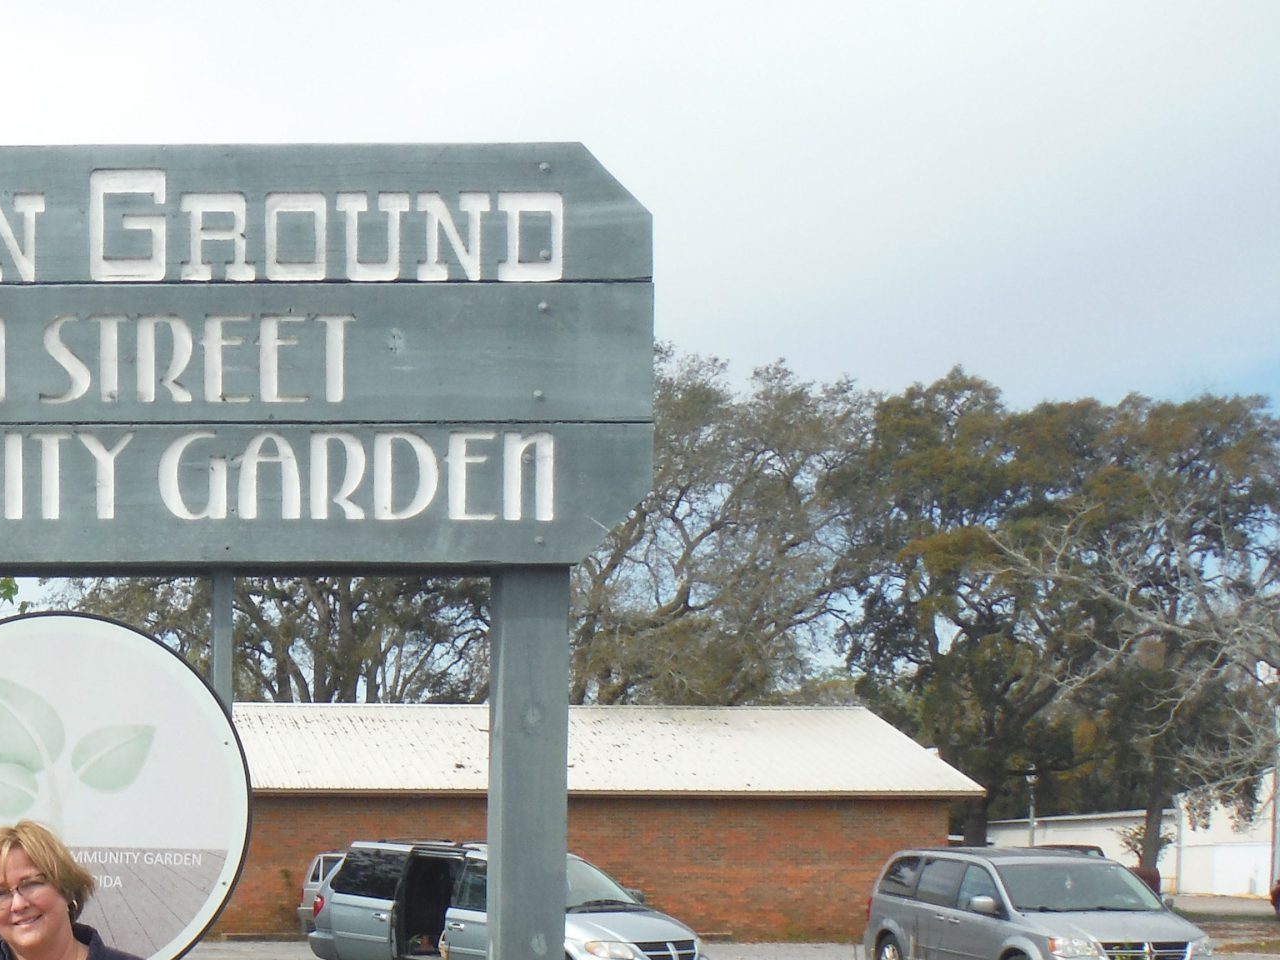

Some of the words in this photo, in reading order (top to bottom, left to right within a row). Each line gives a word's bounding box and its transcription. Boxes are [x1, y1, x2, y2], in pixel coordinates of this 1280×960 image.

[89, 168, 564, 282] GROUND
[39, 313, 357, 404] STREET
[158, 431, 555, 522] GARDEN
[70, 851, 140, 864] MMUNITY
[143, 852, 202, 865] GARDEN
